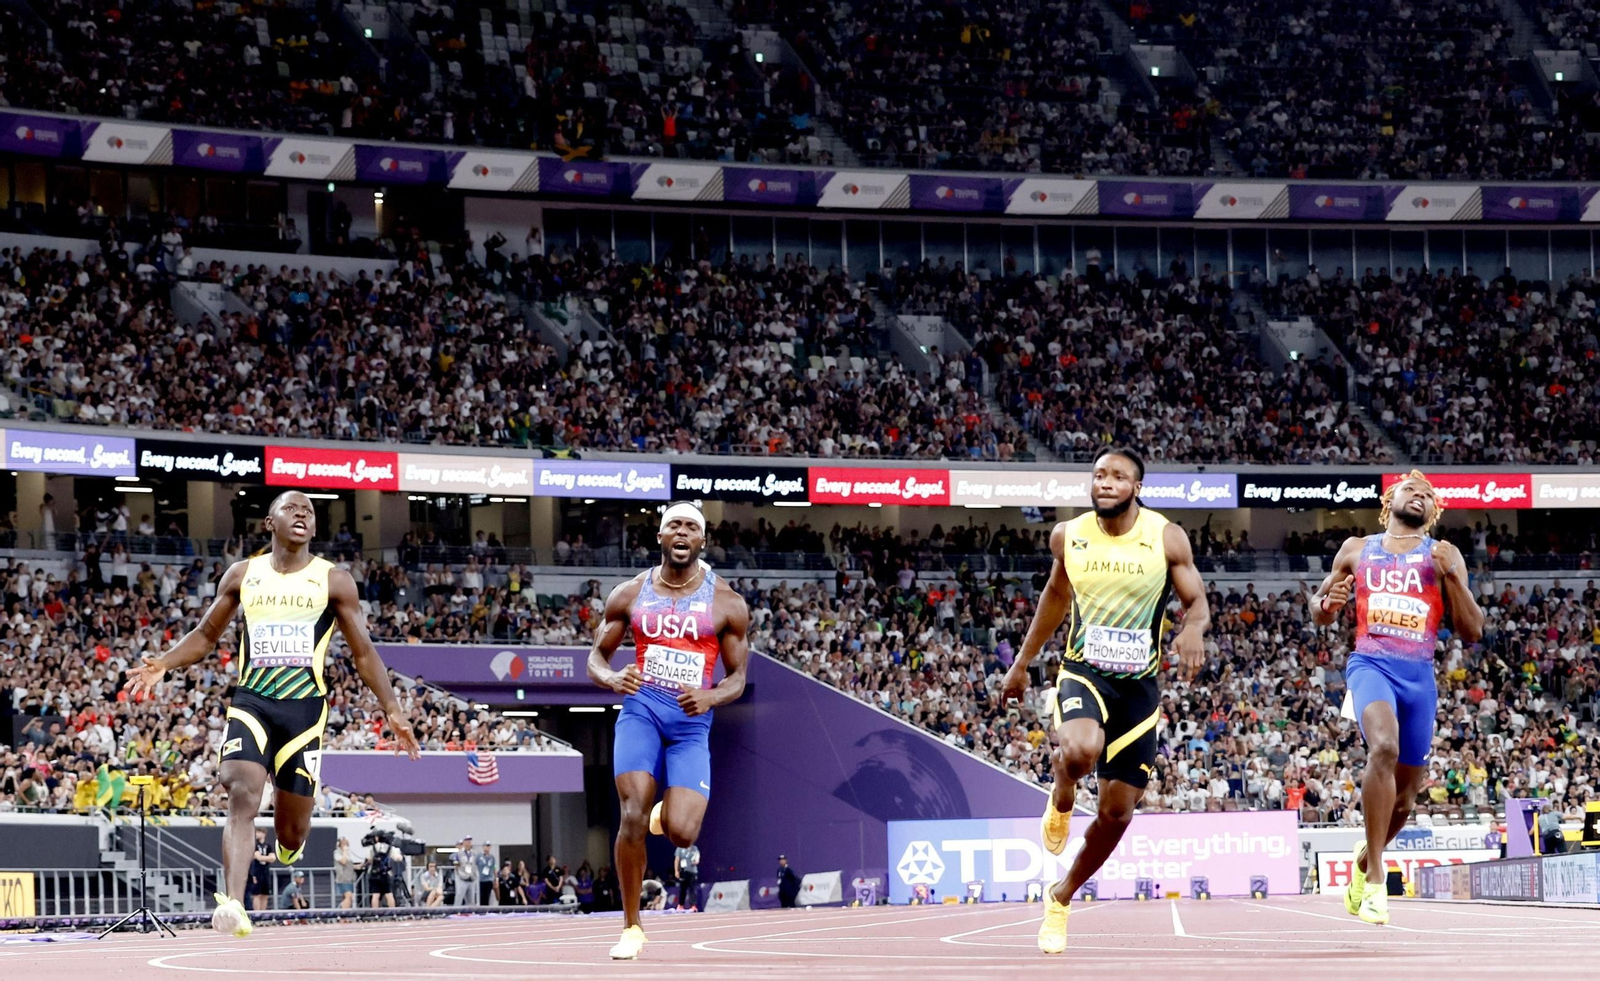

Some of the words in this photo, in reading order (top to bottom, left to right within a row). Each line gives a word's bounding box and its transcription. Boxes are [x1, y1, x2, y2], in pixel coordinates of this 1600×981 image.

[10, 441, 42, 464] Every
[44, 447, 86, 464] second,
[90, 444, 131, 468] Sugoi.
[140, 450, 174, 472] Every
[176, 455, 220, 472] second,
[220, 452, 262, 476] Sugoi.
[272, 458, 306, 479] Every
[308, 462, 352, 480] second,
[352, 458, 394, 483] Sugoi.
[404, 464, 440, 485] Every
[442, 468, 486, 486] second,
[487, 464, 528, 488] Sugoi.
[539, 470, 575, 490] Every
[577, 472, 623, 490] second,
[624, 469, 665, 493] Sugoi.
[676, 474, 713, 494] Every
[714, 476, 761, 494] second,
[762, 473, 804, 496] Sugoi.
[816, 478, 852, 497] Every
[853, 480, 901, 496] second,
[902, 477, 945, 499] Sugoi.
[957, 480, 994, 500] Every
[995, 482, 1042, 498] second,
[1044, 479, 1088, 501] Sugoi.
[1186, 480, 1232, 501] Sugoi.
[1244, 483, 1282, 502] Every
[1282, 484, 1332, 500] second,
[1332, 481, 1378, 502] Sugoi.
[1482, 482, 1526, 503] Sugoi.
[1539, 484, 1578, 501] Every
[1083, 561, 1144, 575] JAMAICA
[1366, 567, 1423, 593] USA
[249, 595, 314, 609] JAMAICA
[1384, 595, 1423, 613] TDK
[641, 614, 699, 640] USA
[1373, 610, 1419, 628] LYLES
[266, 625, 308, 637] TDK
[1104, 630, 1146, 644] TDK
[254, 641, 310, 654] SEVILLE
[1088, 643, 1147, 660] THOMPSON
[662, 649, 699, 667] TDK
[646, 660, 699, 683] BEDNAREK
[311, 757, 317, 773] 7
[941, 838, 1087, 883] TDK
[1131, 832, 1292, 860] Everything,
[1103, 858, 1193, 880] Better
[861, 888, 871, 901] 9
[968, 884, 982, 897] 7
[1139, 880, 1151, 896] 4
[1194, 880, 1205, 893] 3
[1253, 880, 1264, 892] 2
